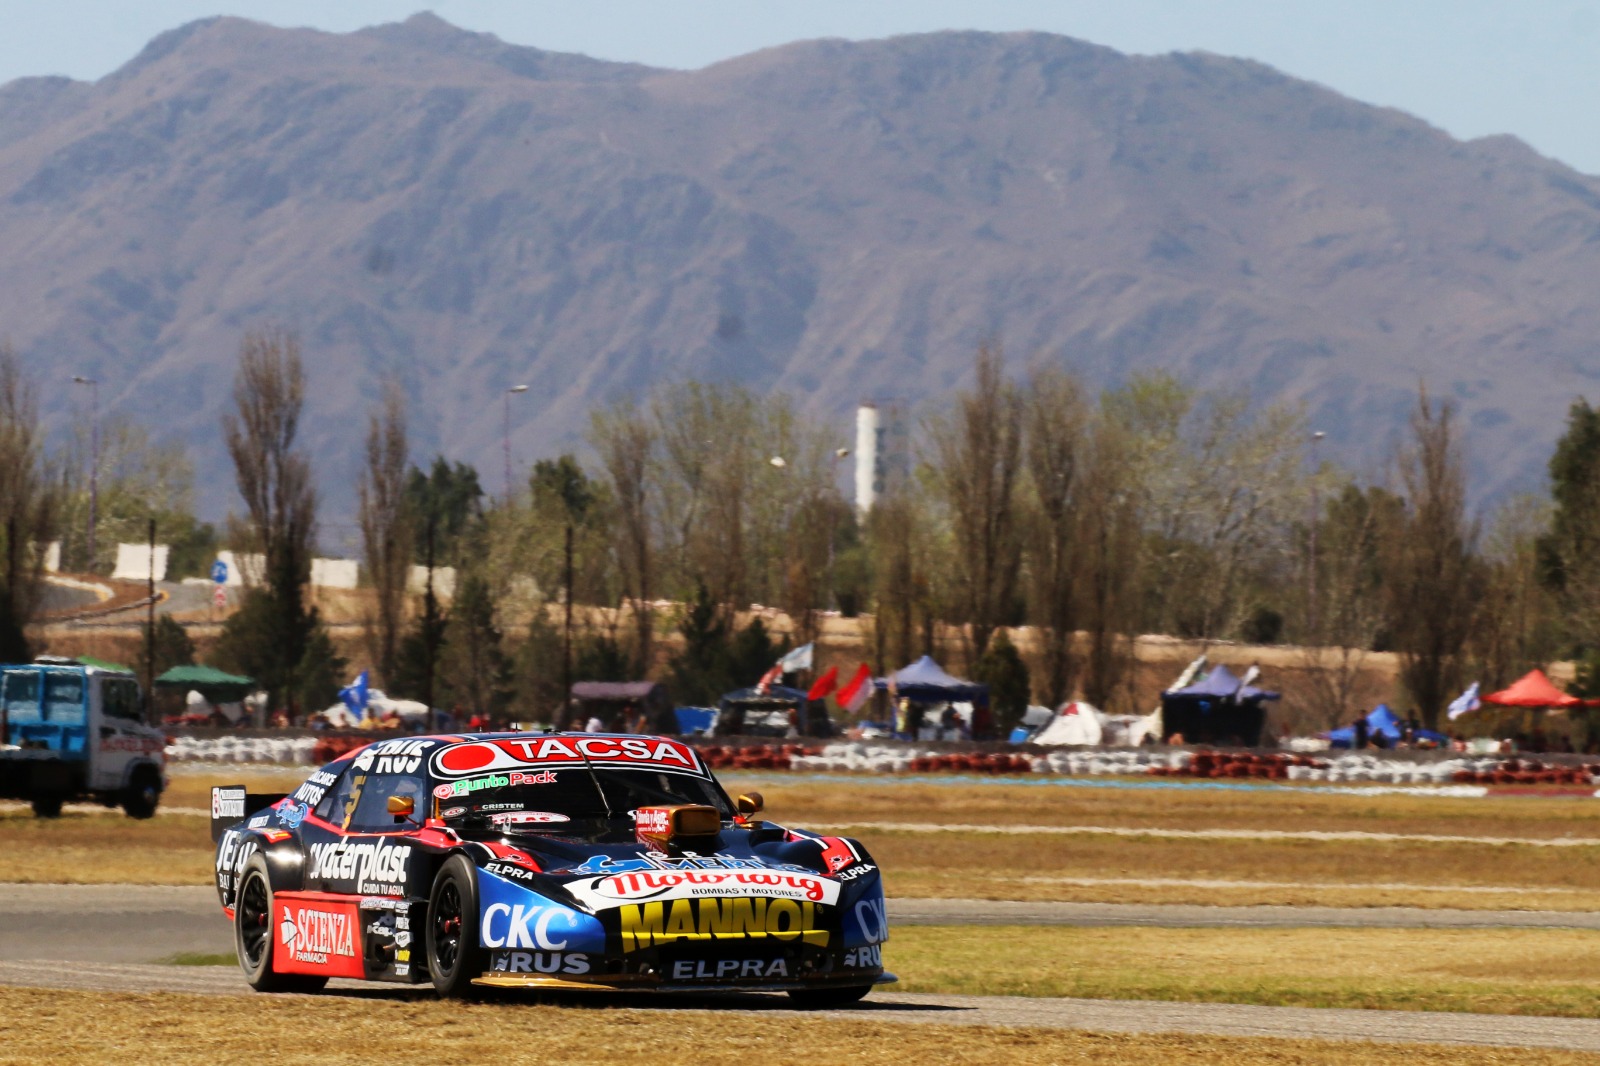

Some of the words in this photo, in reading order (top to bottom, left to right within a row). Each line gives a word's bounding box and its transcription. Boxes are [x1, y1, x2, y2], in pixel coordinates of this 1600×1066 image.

[375, 740, 436, 774] RUS
[510, 738, 691, 766] TACSA
[294, 782, 325, 807] AUTOS
[309, 835, 412, 893] waterplast
[483, 862, 535, 881] ELPRA
[840, 863, 877, 881] ELPRA
[363, 883, 380, 894] CUIDA
[380, 884, 389, 894] TU
[388, 885, 405, 896] AGUA
[604, 871, 824, 902] Motorarg
[691, 887, 740, 895] BOMBAS
[752, 887, 802, 897] MOTORES
[297, 908, 355, 957] SCIENZA
[482, 902, 576, 951] CKC
[620, 897, 830, 954] MANNOL
[296, 950, 328, 965] FARMACIA
[509, 951, 591, 974] RUS
[672, 958, 789, 980] ELPRA
